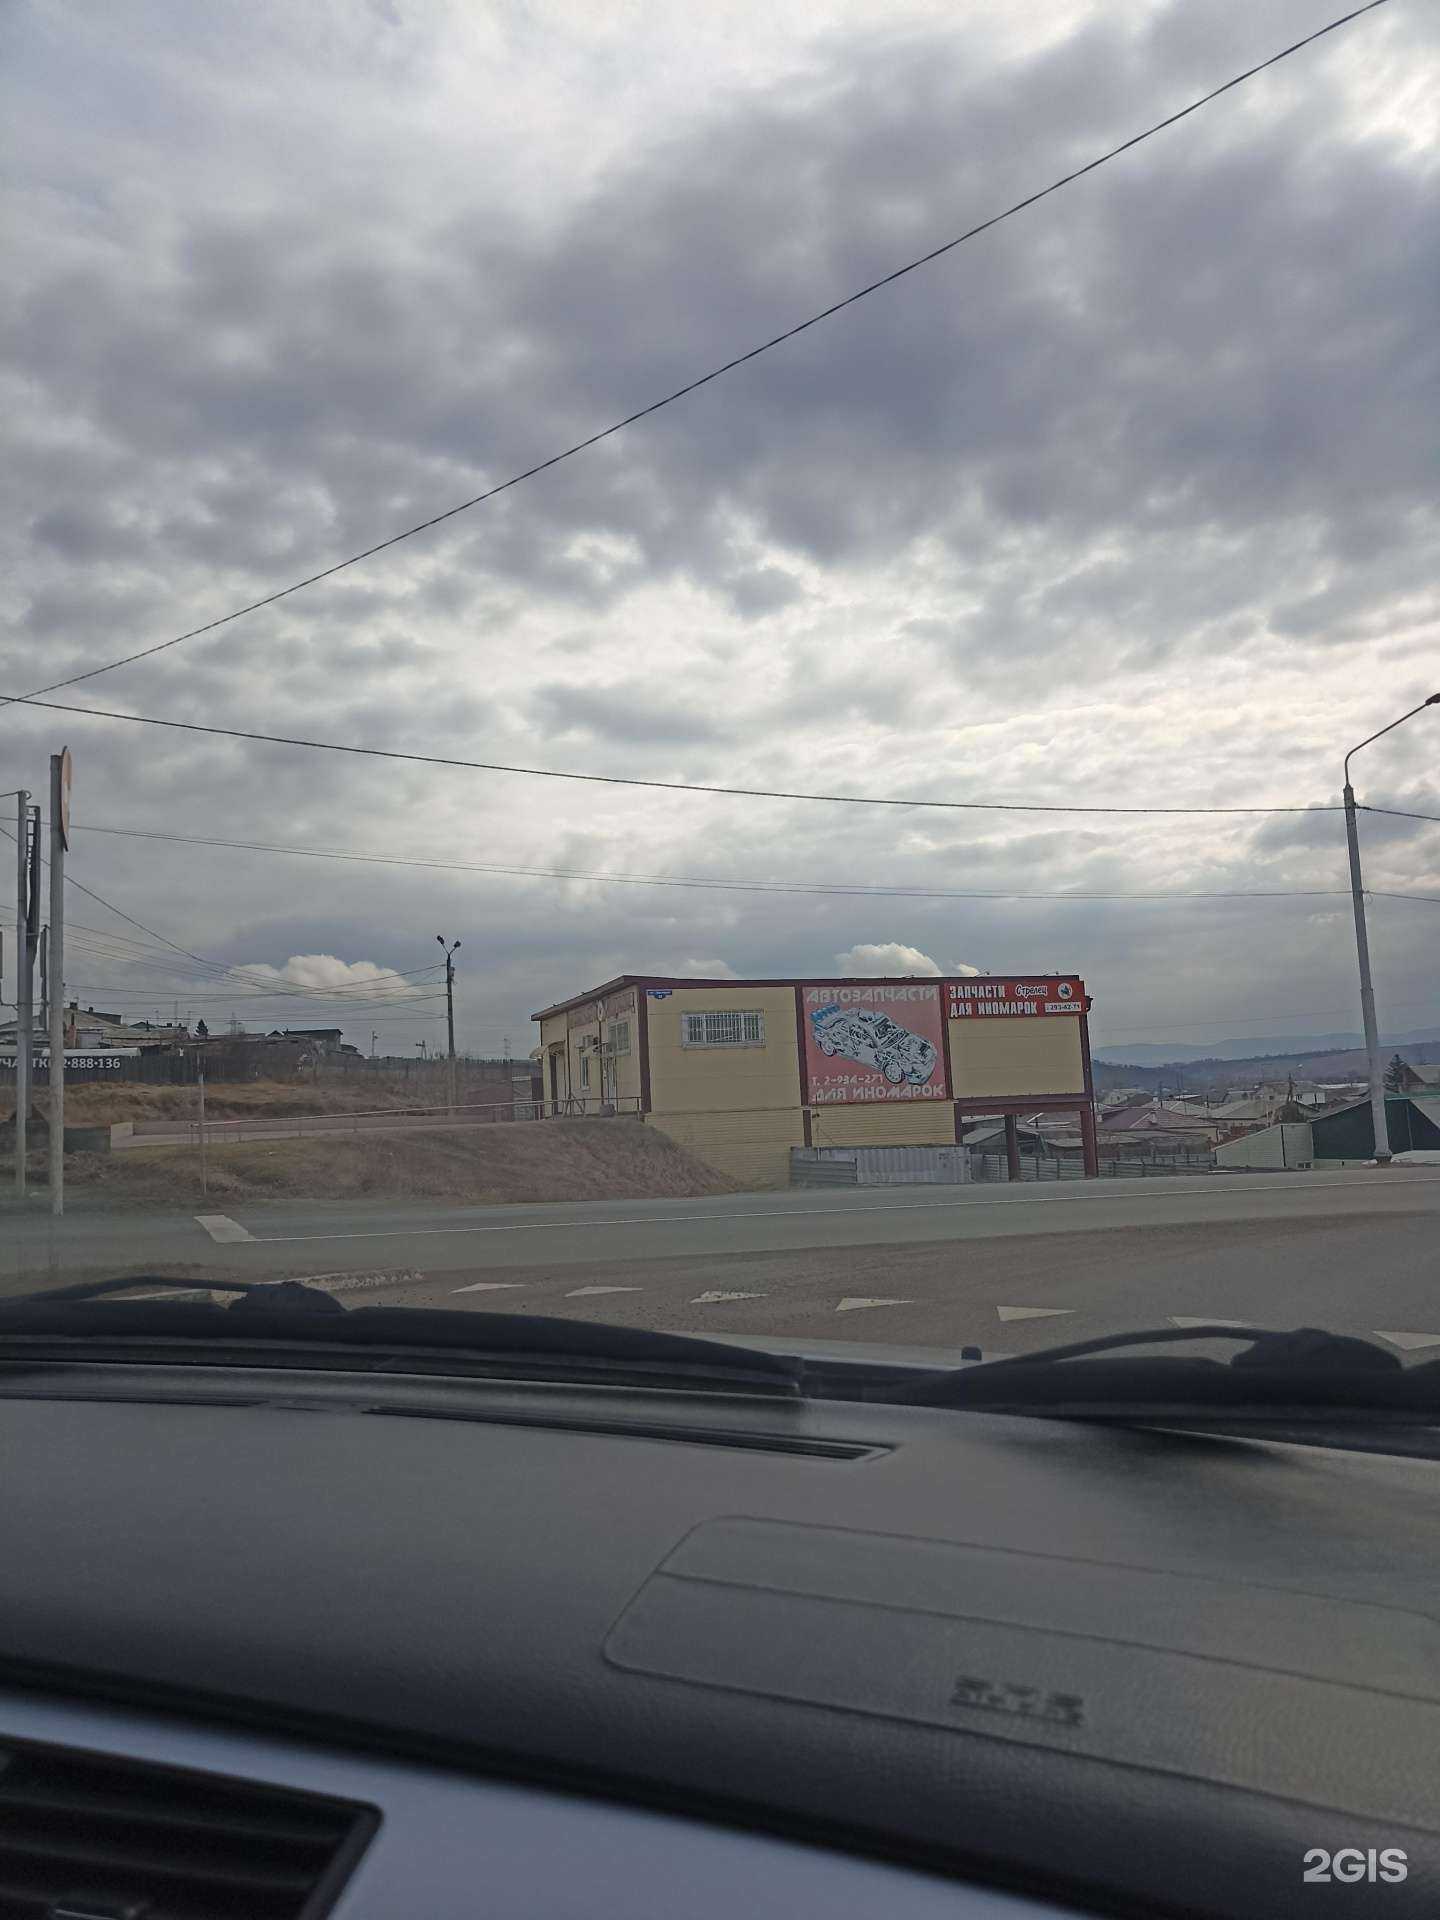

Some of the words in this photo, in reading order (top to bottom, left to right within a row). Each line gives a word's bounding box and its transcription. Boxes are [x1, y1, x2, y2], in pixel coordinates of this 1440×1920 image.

[806, 987, 938, 1003] АВТОЗАПЧАСТИ
[949, 985, 1006, 999] ЗАПЧАСТИ
[1015, 984, 1048, 999] Стрелец
[950, 1002, 973, 1018] ДЛЯ
[977, 1001, 1038, 1015] ИНОМАРОК
[812, 1087, 847, 1102] ДЛЯ
[852, 1084, 944, 1101] ИНОМАРОК
